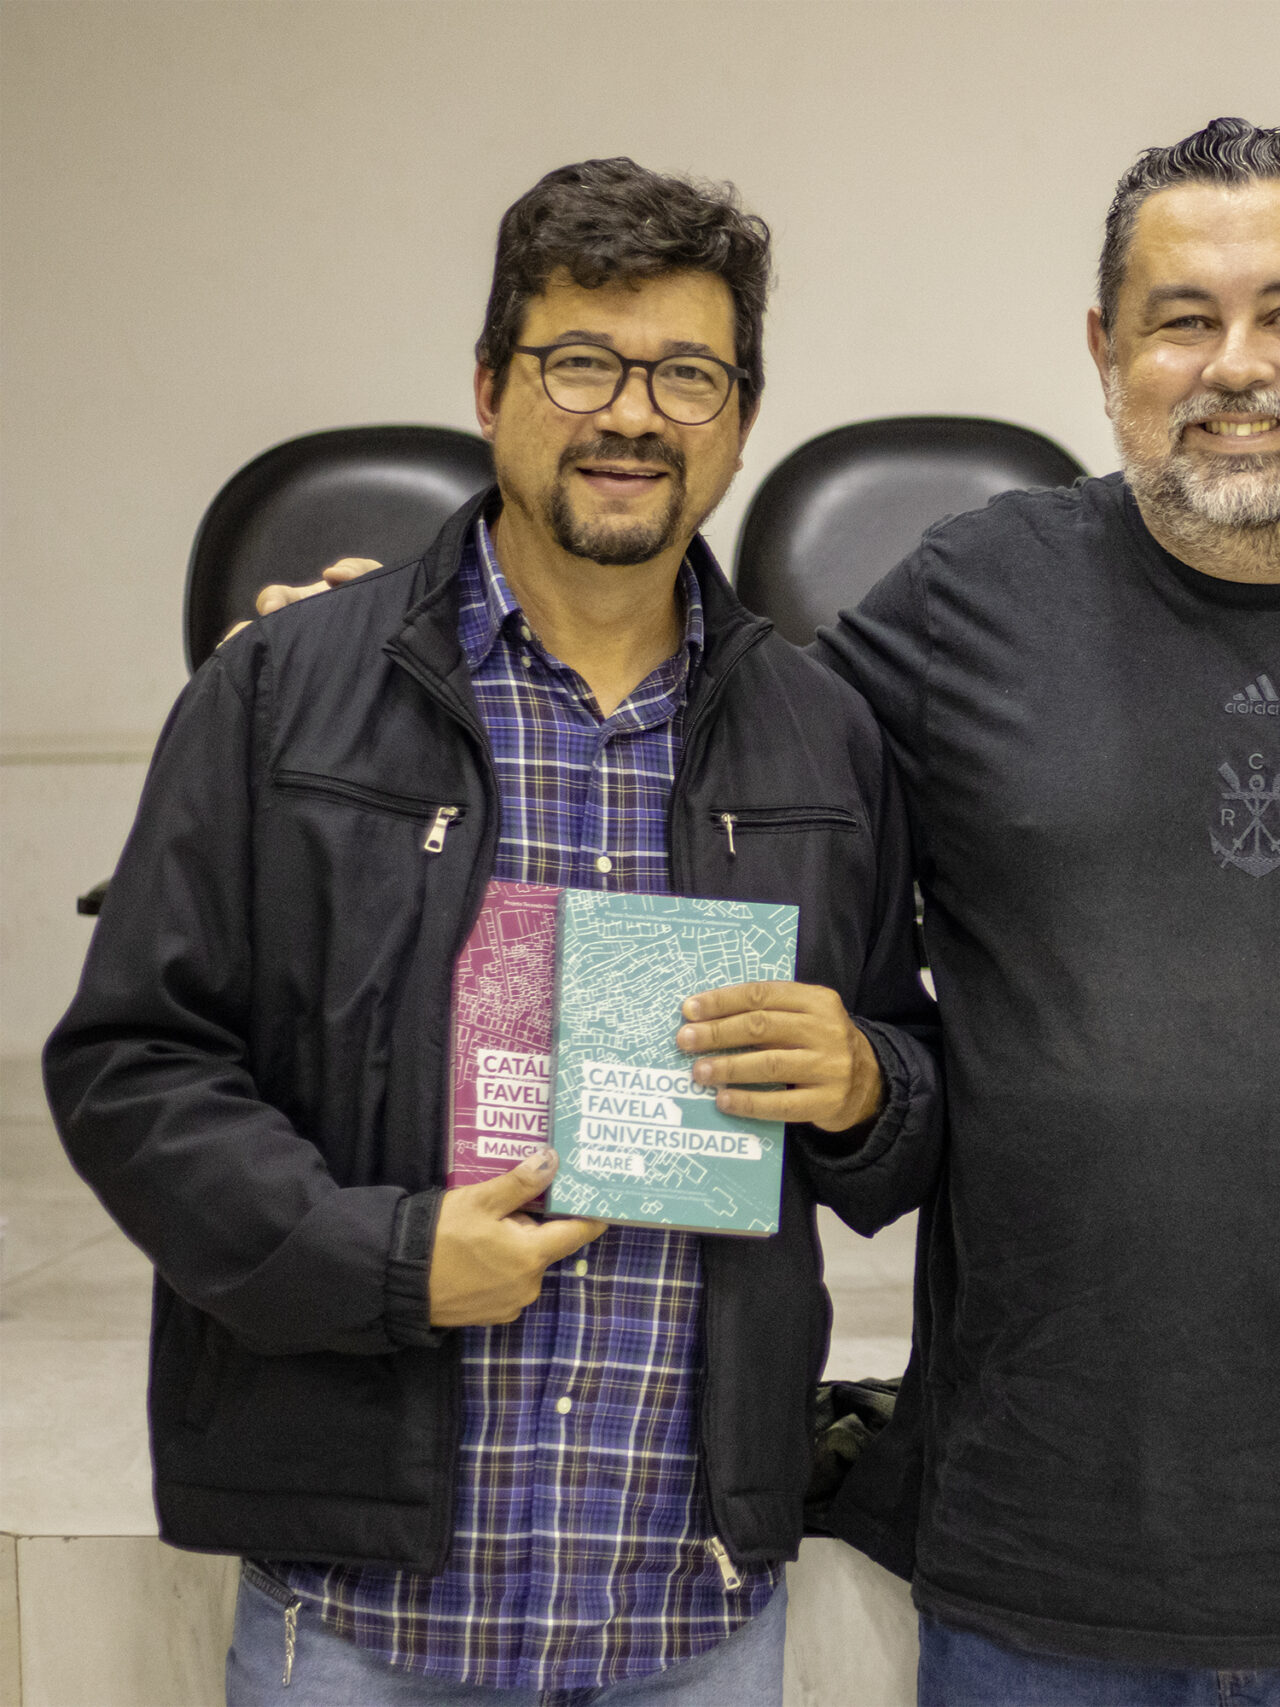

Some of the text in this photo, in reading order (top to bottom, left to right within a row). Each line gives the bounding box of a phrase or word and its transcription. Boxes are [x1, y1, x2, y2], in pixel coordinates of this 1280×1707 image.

[1248, 753, 1264, 769] C
[1220, 809, 1236, 826] R
[484, 1083, 549, 1106] FAVEL
[588, 1095, 668, 1120] FAVELA
[587, 1122, 750, 1155] UNIVERSIDADE
[587, 1154, 633, 1172] MARÉ
